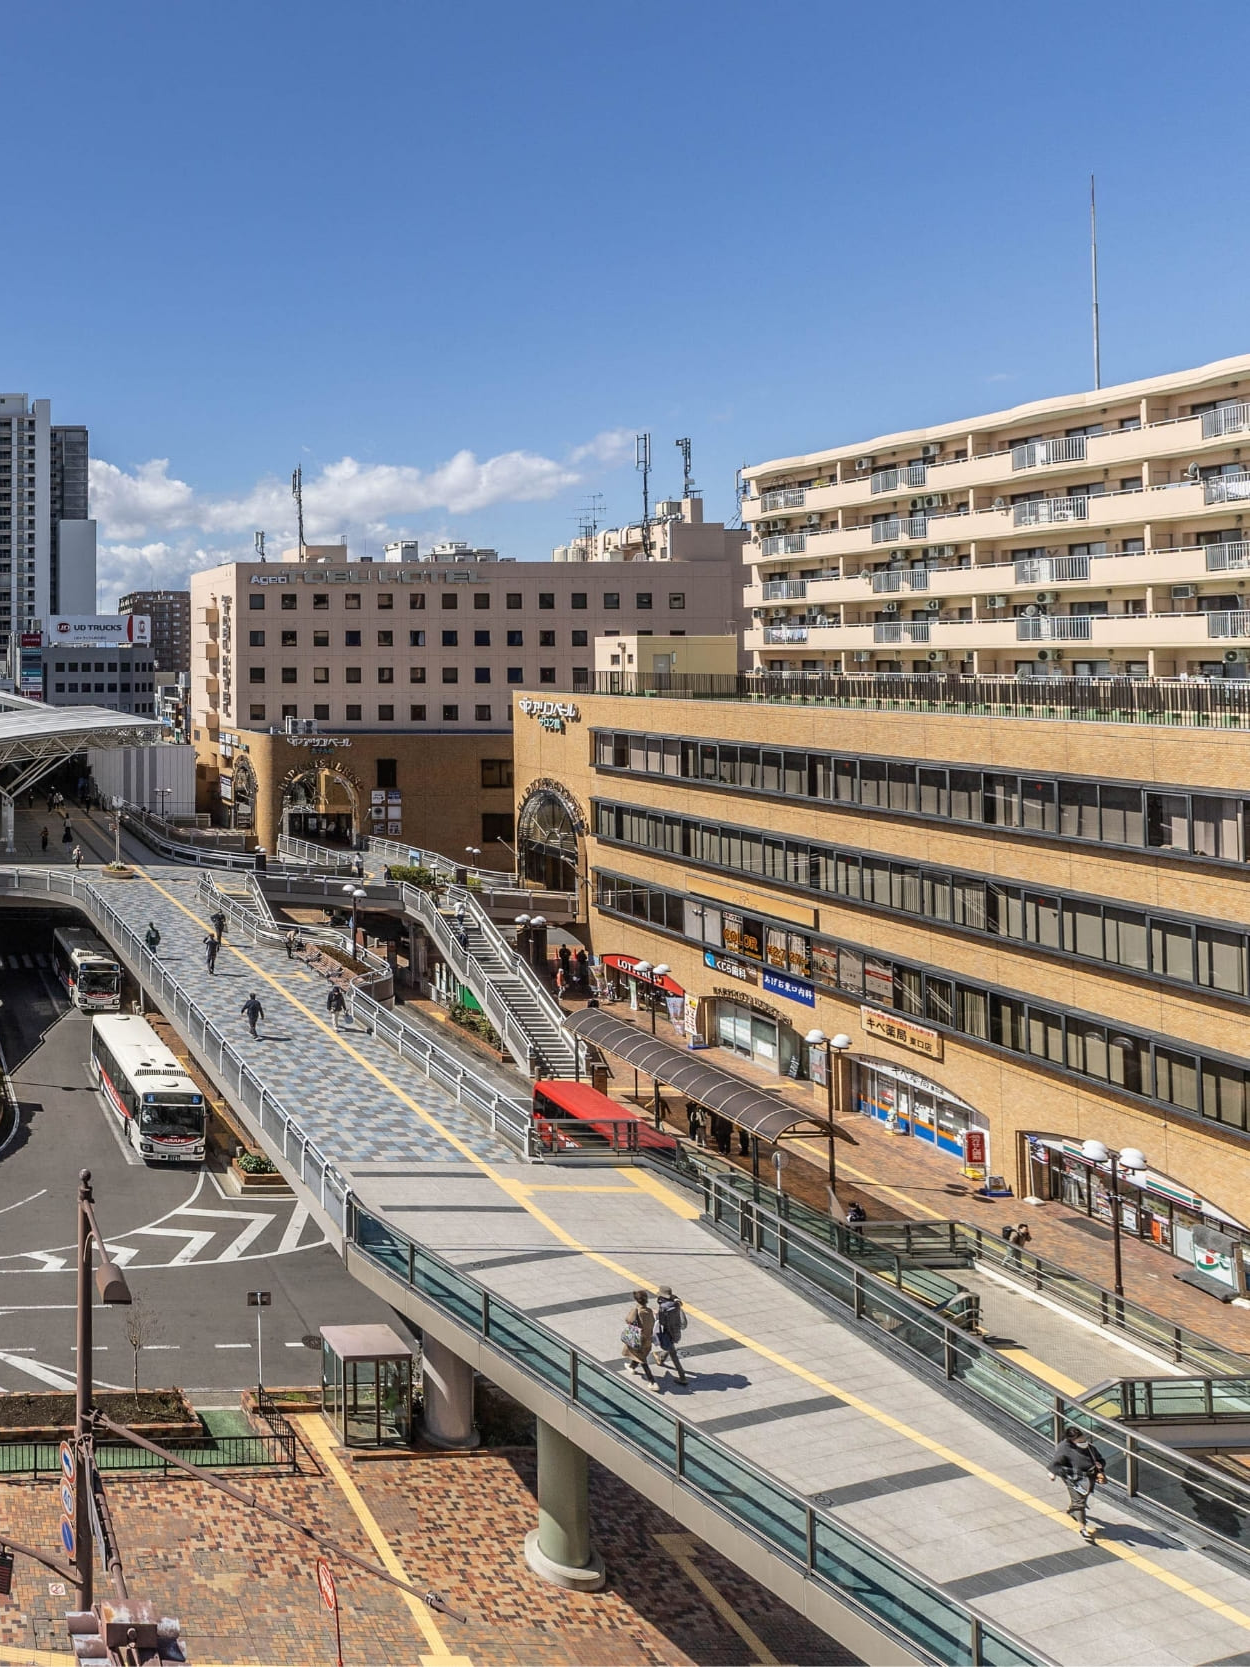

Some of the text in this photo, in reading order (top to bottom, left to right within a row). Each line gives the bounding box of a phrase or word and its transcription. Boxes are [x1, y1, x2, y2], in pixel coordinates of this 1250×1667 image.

[250, 569, 491, 586] Ageo TOBU HOTEL
[723, 928, 759, 952] COLOR
[764, 974, 813, 1000] あげお東口内科
